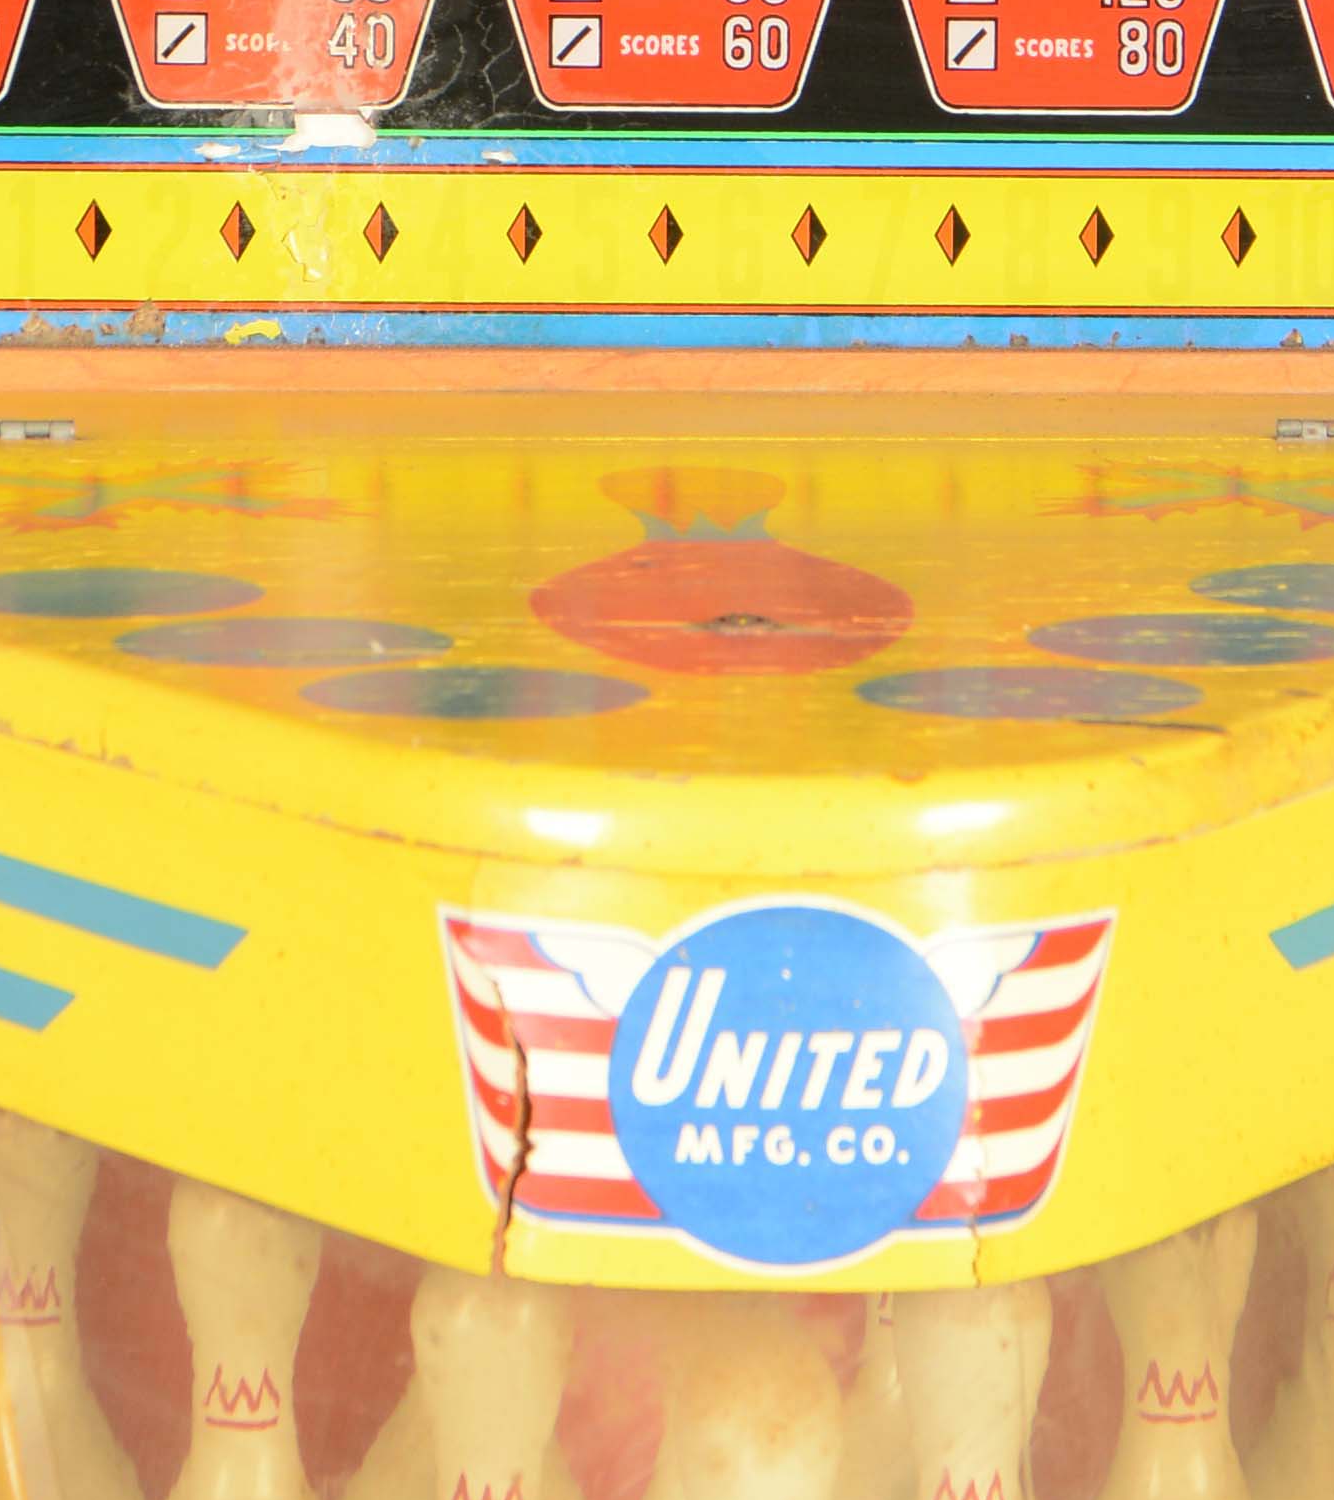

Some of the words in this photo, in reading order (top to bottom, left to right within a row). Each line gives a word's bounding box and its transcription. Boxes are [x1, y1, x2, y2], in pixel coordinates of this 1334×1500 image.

[327, 12, 396, 69] 40
[619, 34, 701, 57] SCORES
[722, 14, 791, 71] 60
[1014, 37, 1094, 58] SCORES
[1117, 18, 1185, 77] 80
[631, 967, 949, 1109] UNITED
[675, 1124, 811, 1166] MFG.
[826, 1125, 910, 1164] CO.
